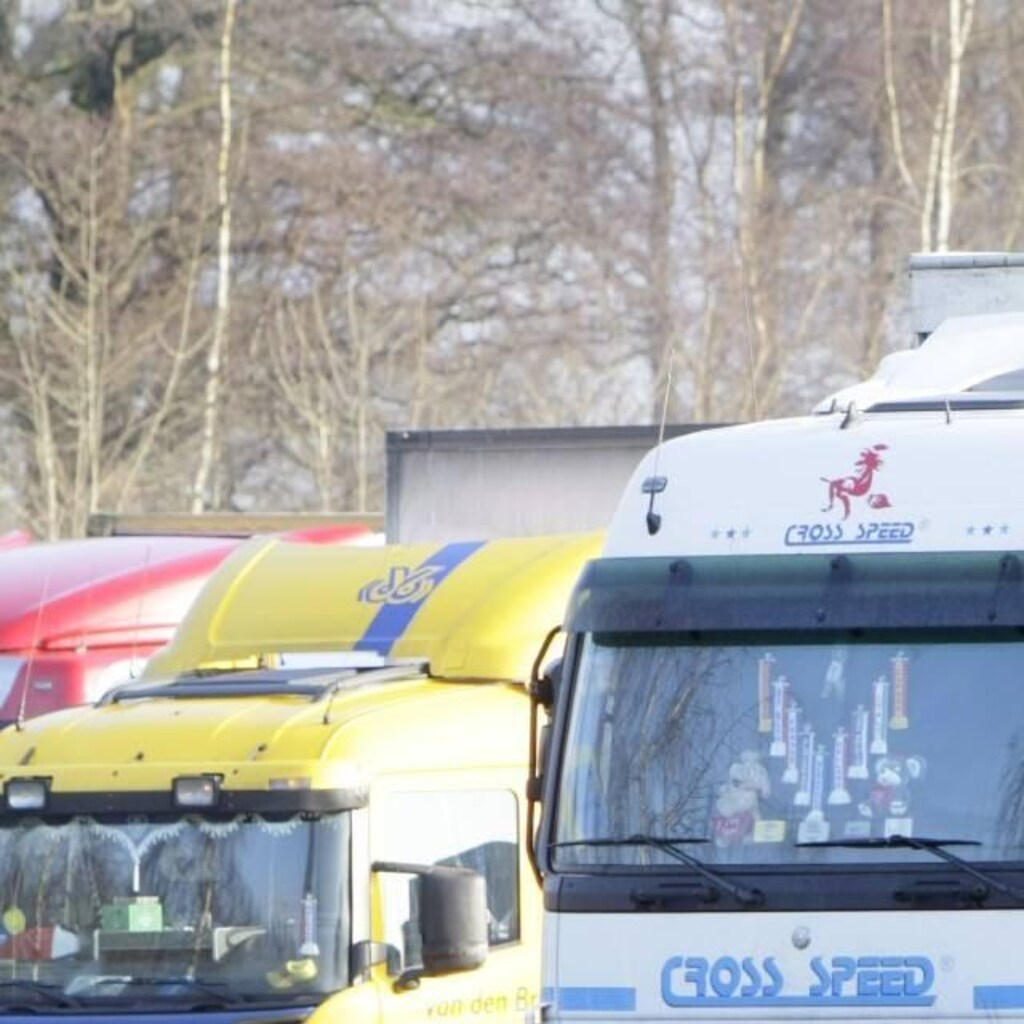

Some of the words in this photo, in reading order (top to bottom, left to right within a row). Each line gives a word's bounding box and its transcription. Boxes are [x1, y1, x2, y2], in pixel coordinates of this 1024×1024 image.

[785, 525, 843, 546] CROSS
[857, 522, 914, 542] SPEED
[661, 956, 785, 1007] CROSS
[809, 956, 937, 1004] SPEED
[470, 988, 508, 1014] den
